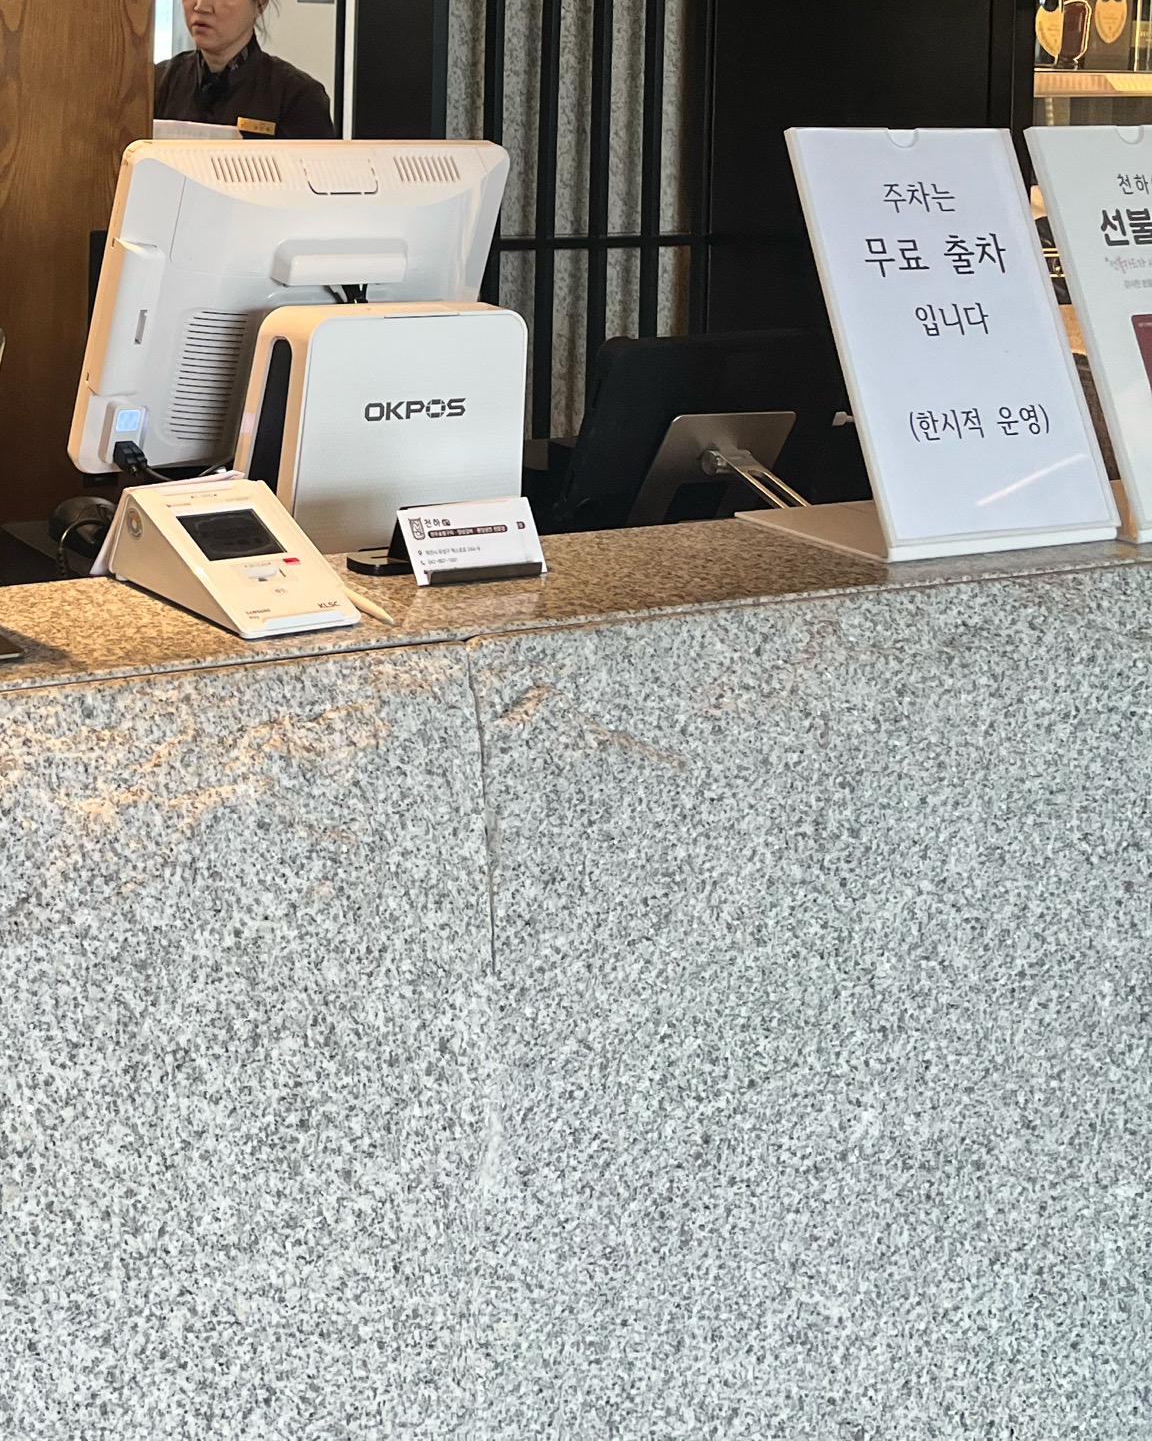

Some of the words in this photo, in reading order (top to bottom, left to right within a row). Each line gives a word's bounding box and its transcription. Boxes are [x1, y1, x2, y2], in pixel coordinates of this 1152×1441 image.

[883, 181, 956, 213] 주차는
[1117, 173, 1152, 195] 천하
[864, 237, 930, 278] 무료
[943, 232, 1007, 274] 출차
[915, 302, 989, 336] 입니다
[364, 398, 467, 422] OKPOS
[909, 408, 985, 443] (한시적
[997, 404, 1050, 436] 운영)
